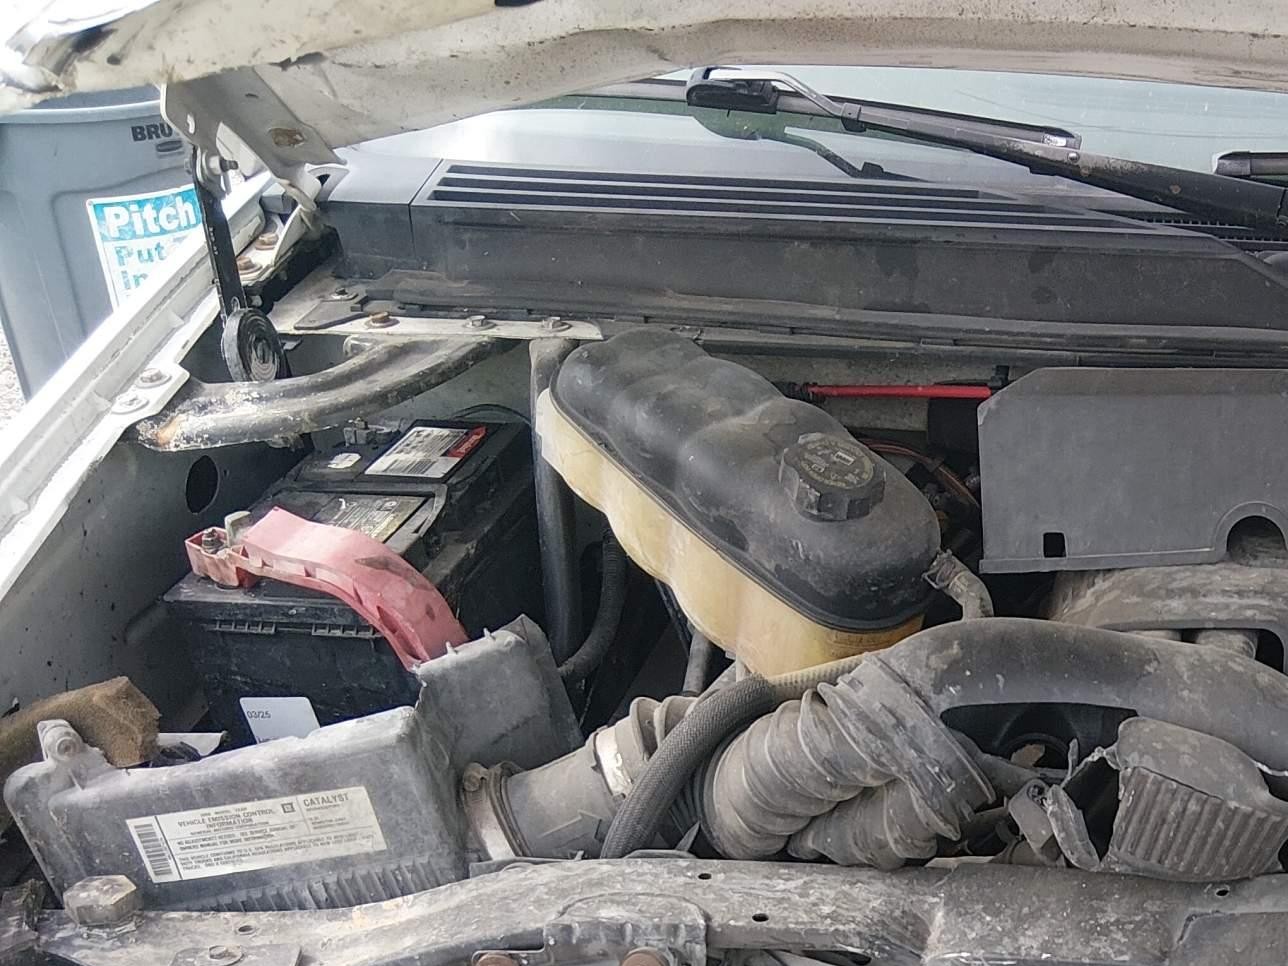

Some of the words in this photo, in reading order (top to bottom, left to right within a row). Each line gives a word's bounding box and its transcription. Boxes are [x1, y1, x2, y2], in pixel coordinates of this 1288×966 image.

[131, 123, 179, 142] BRU
[103, 196, 197, 238] Pitch
[114, 242, 167, 266] Put
[246, 710, 272, 719] 03/25
[304, 793, 349, 807] CATALYST
[178, 819, 206, 828] VEHICLE
[208, 813, 241, 823] EMISSION
[243, 808, 273, 818] CONTROL
[207, 818, 253, 829] INFORMATION
